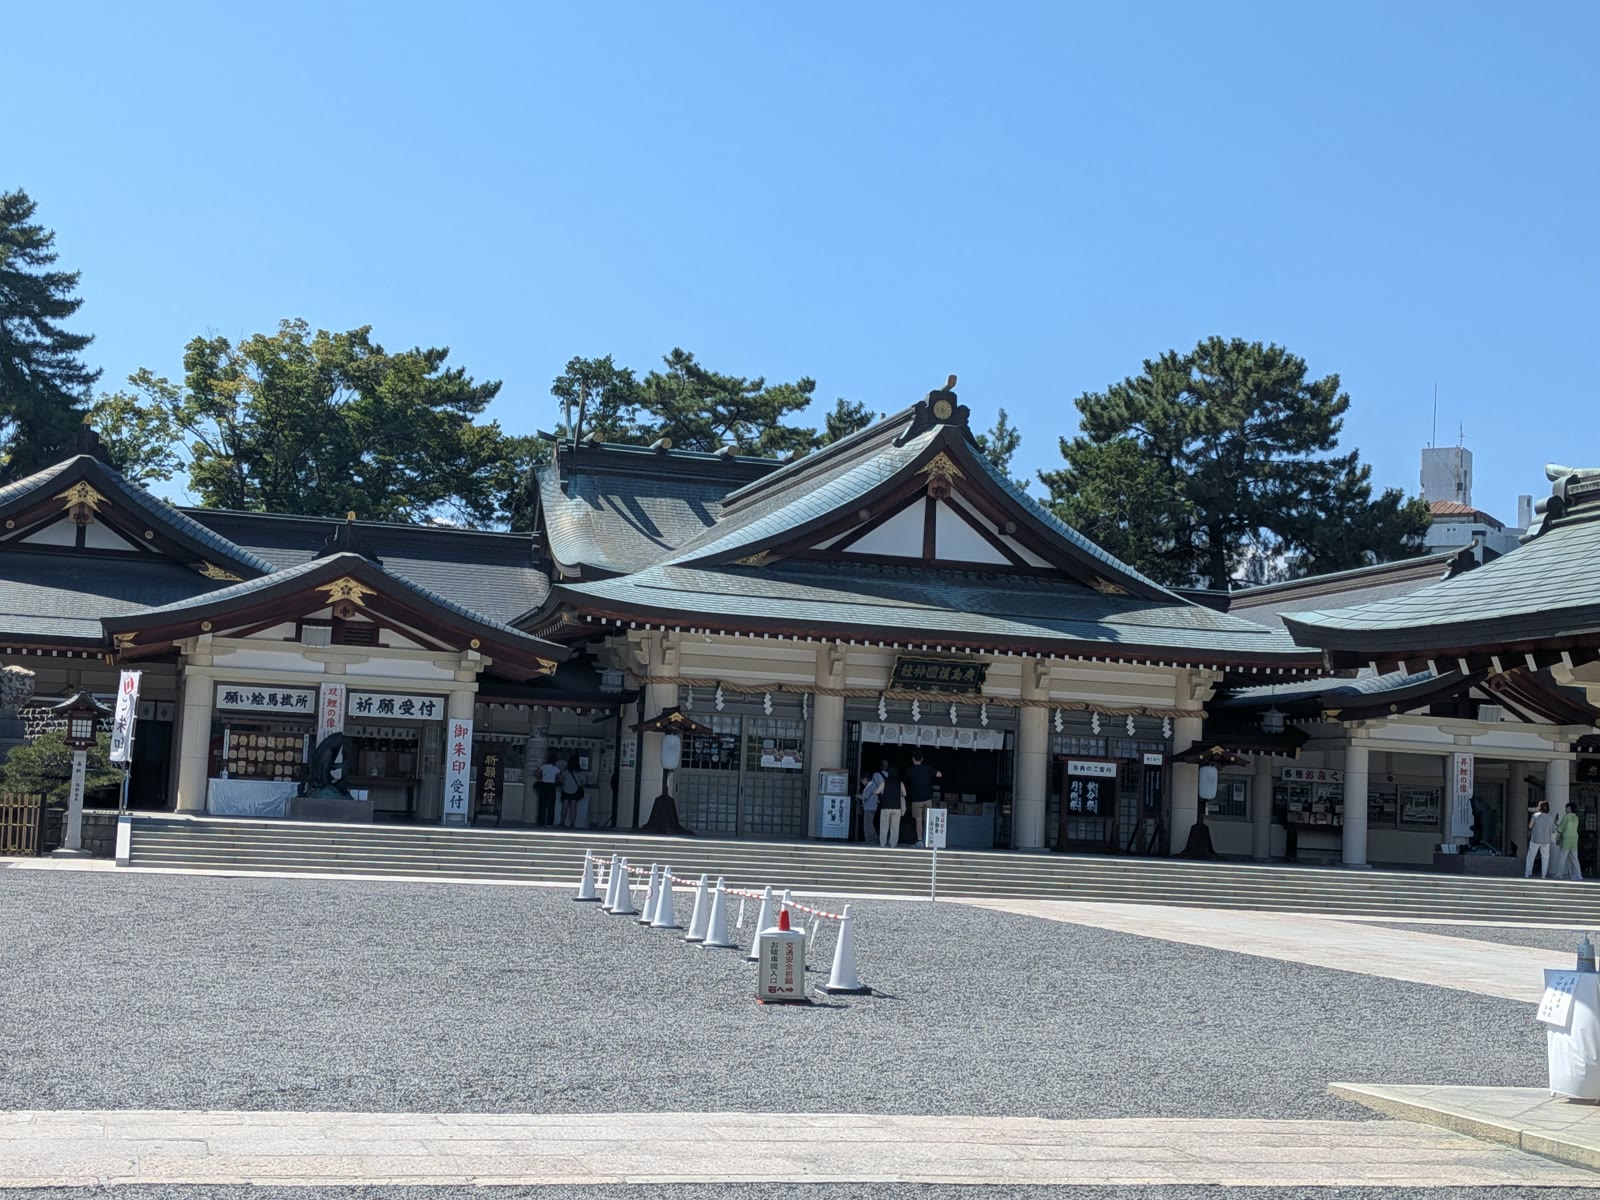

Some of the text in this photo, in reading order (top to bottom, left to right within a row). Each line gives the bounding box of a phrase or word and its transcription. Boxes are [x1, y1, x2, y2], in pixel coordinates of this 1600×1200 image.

[326, 688, 338, 729] 双鯉の像
[356, 696, 436, 716] 祈願受付
[449, 724, 469, 809] 御朱印受付
[482, 755, 499, 805] 祈願受付
[1284, 769, 1344, 782] 各種おみく
[785, 942, 794, 985] 交通安全祈願
